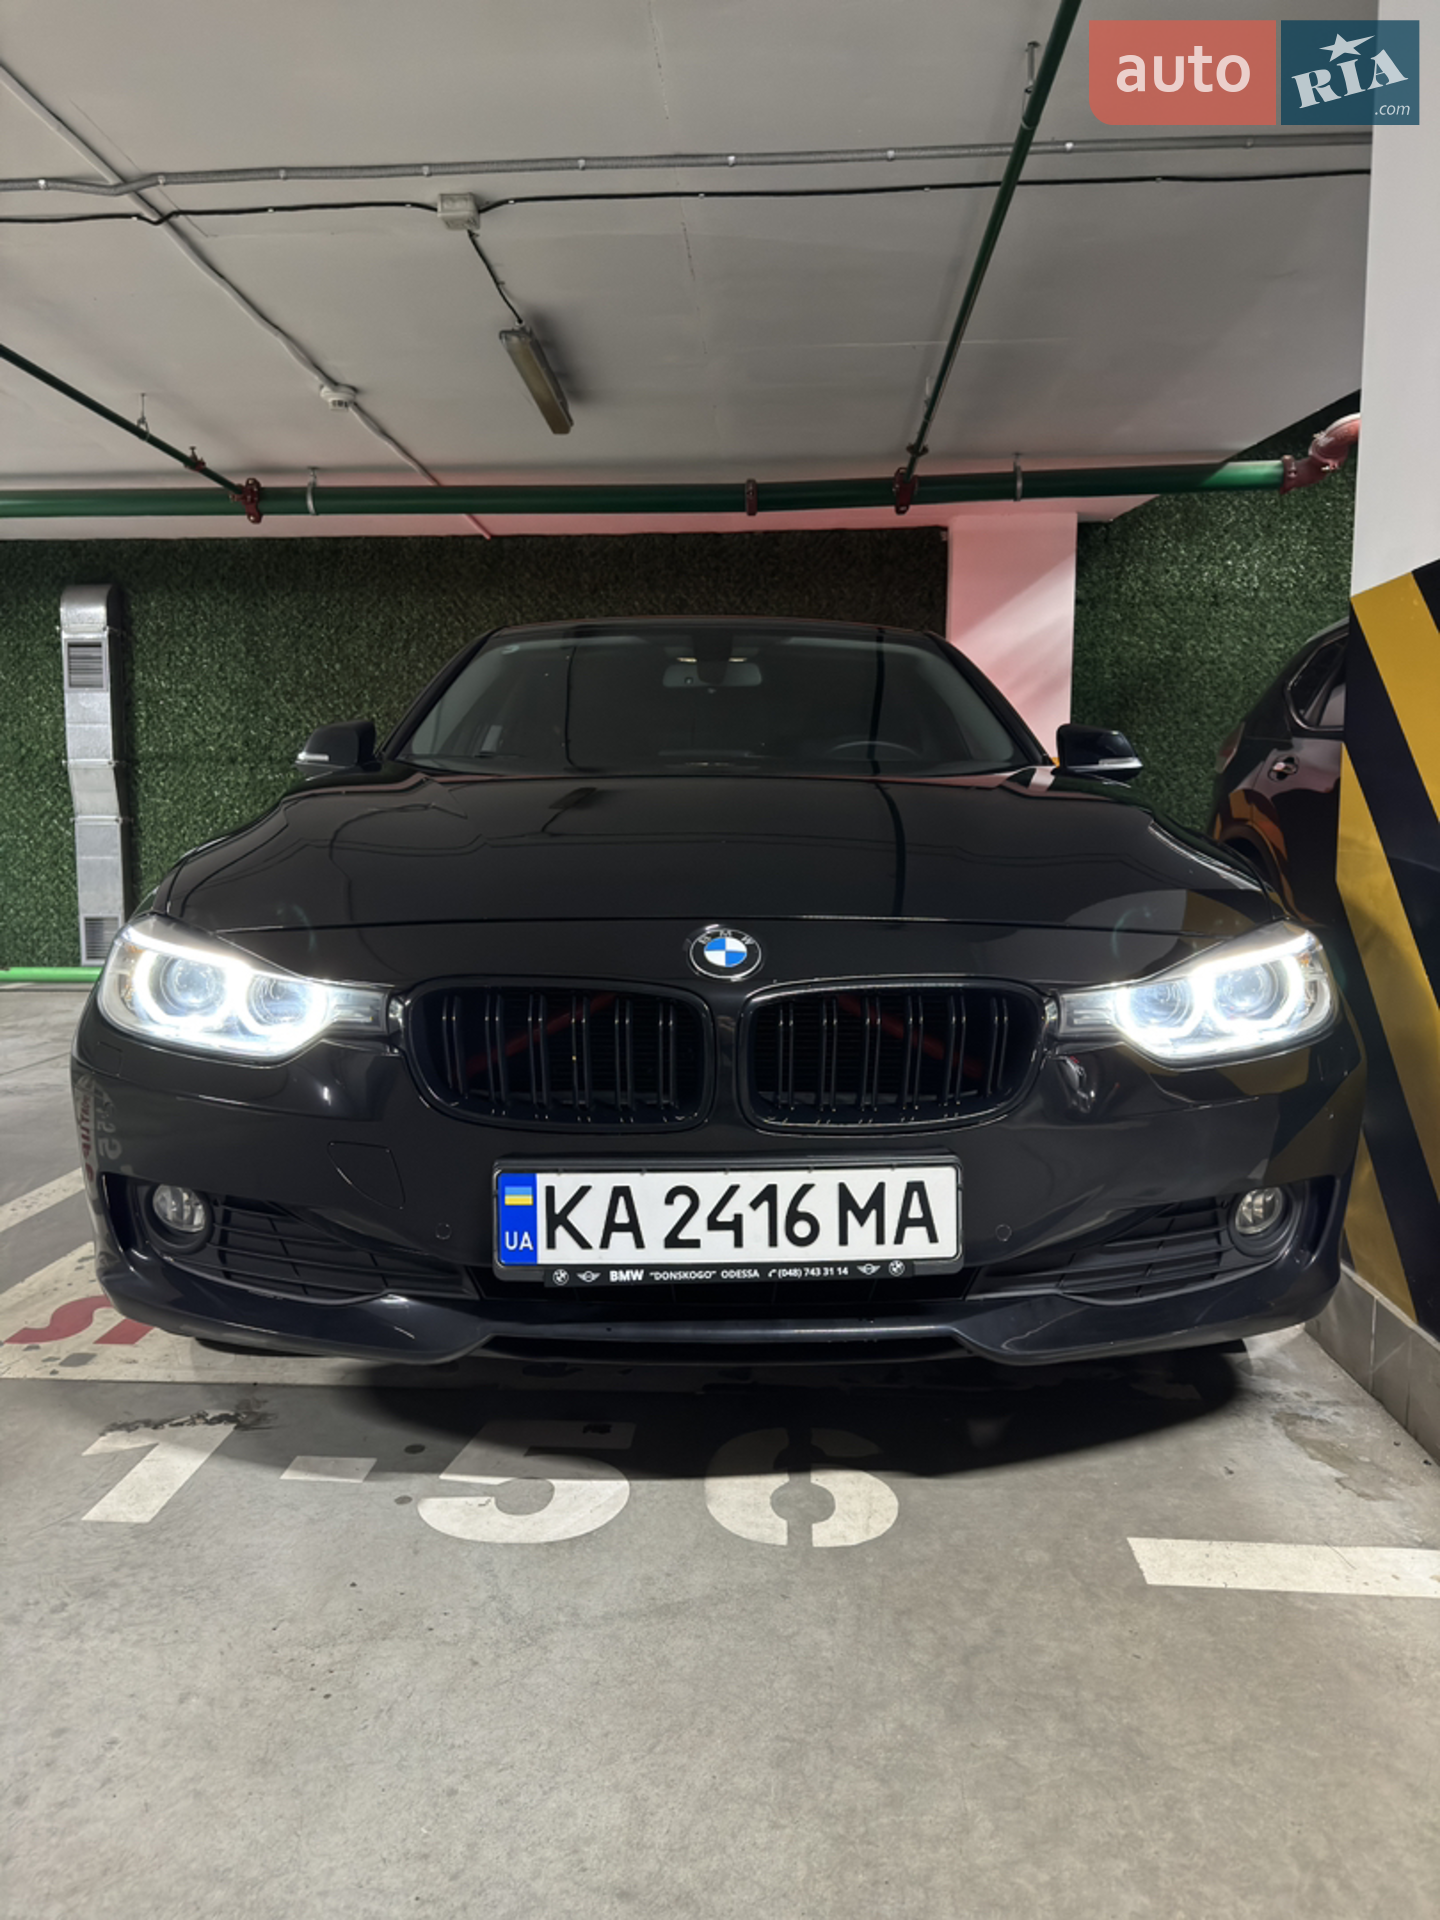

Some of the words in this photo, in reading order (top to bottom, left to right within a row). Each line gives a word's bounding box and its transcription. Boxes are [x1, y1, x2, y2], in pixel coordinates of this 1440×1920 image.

[545, 1185, 646, 1250] KA
[663, 1183, 820, 1249] 2416
[838, 1180, 939, 1246] MA
[504, 1231, 533, 1252] UA
[609, 1269, 644, 1282] BMW
[721, 1269, 760, 1280] ODESSA
[778, 1267, 802, 1279] (048)
[804, 1267, 821, 1277] 743
[823, 1266, 835, 1276] 31
[837, 1266, 849, 1276] 14
